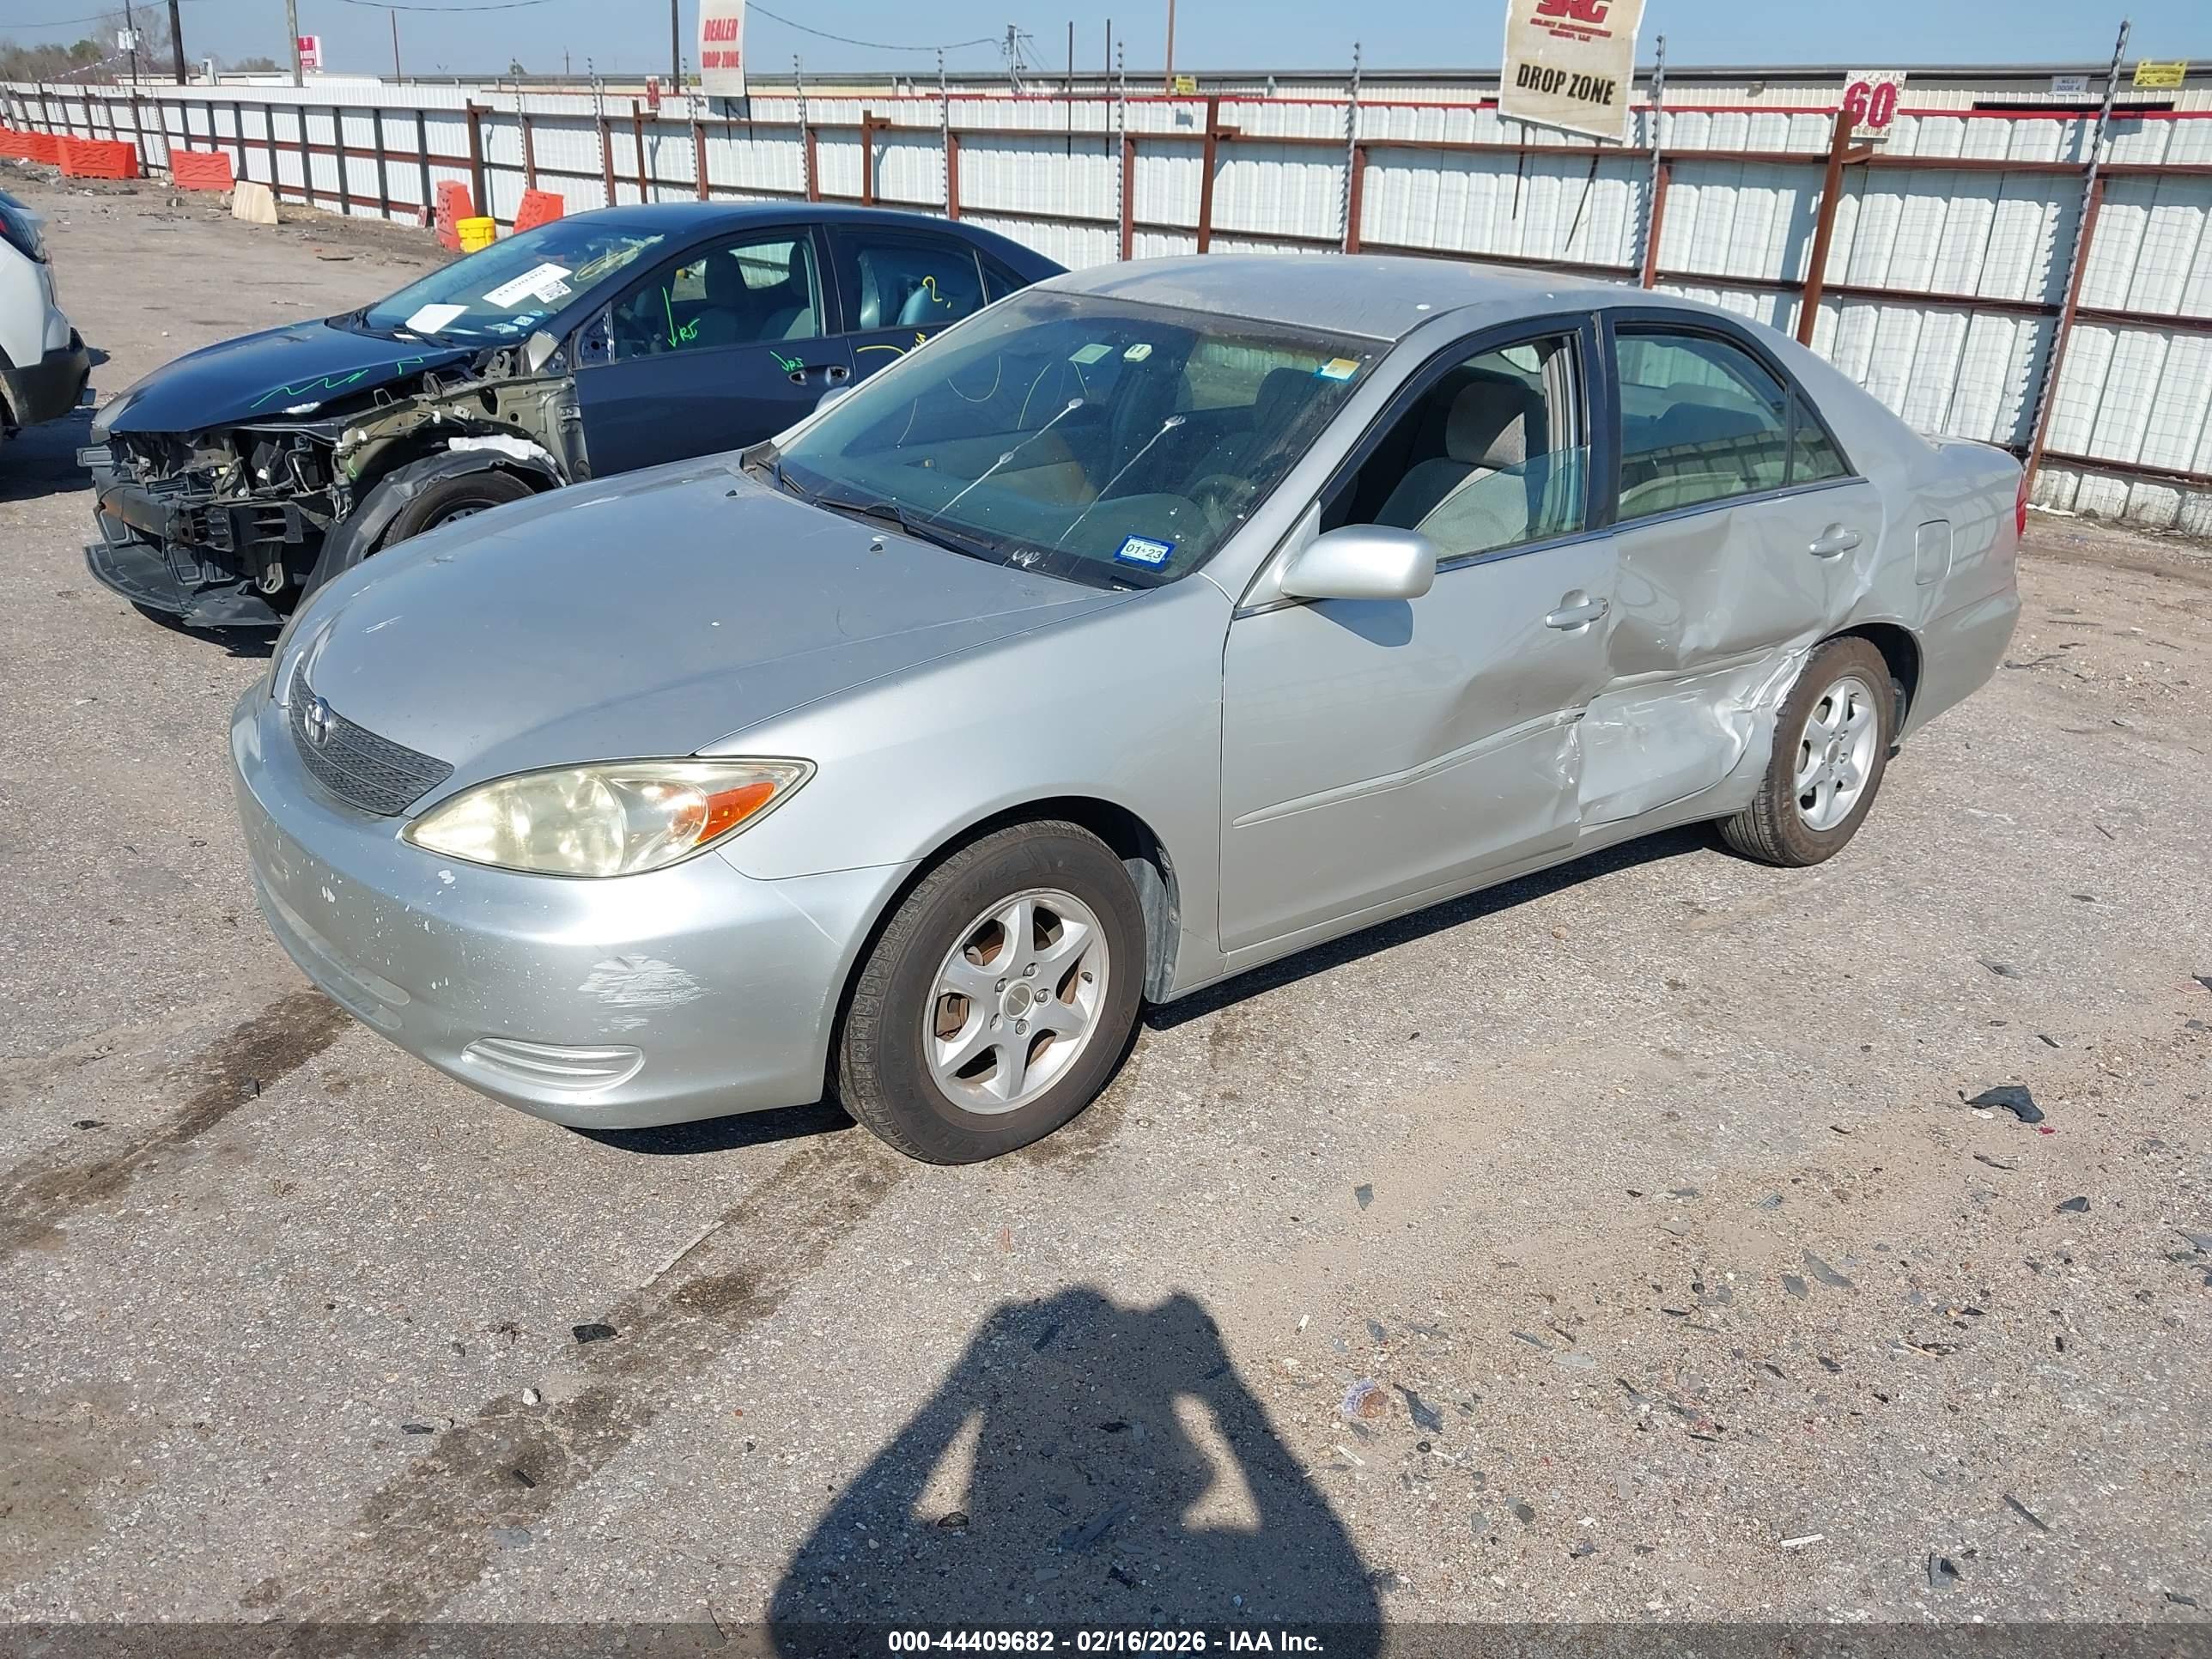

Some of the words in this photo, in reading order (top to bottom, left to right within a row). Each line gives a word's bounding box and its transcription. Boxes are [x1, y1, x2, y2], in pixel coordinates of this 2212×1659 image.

[703, 19, 738, 41] DEALER
[702, 51, 720, 69] DROP
[721, 51, 739, 68] ZONE
[1516, 64, 1566, 94] DROP
[1567, 73, 1616, 106] ZONE
[1844, 82, 1896, 128] 60
